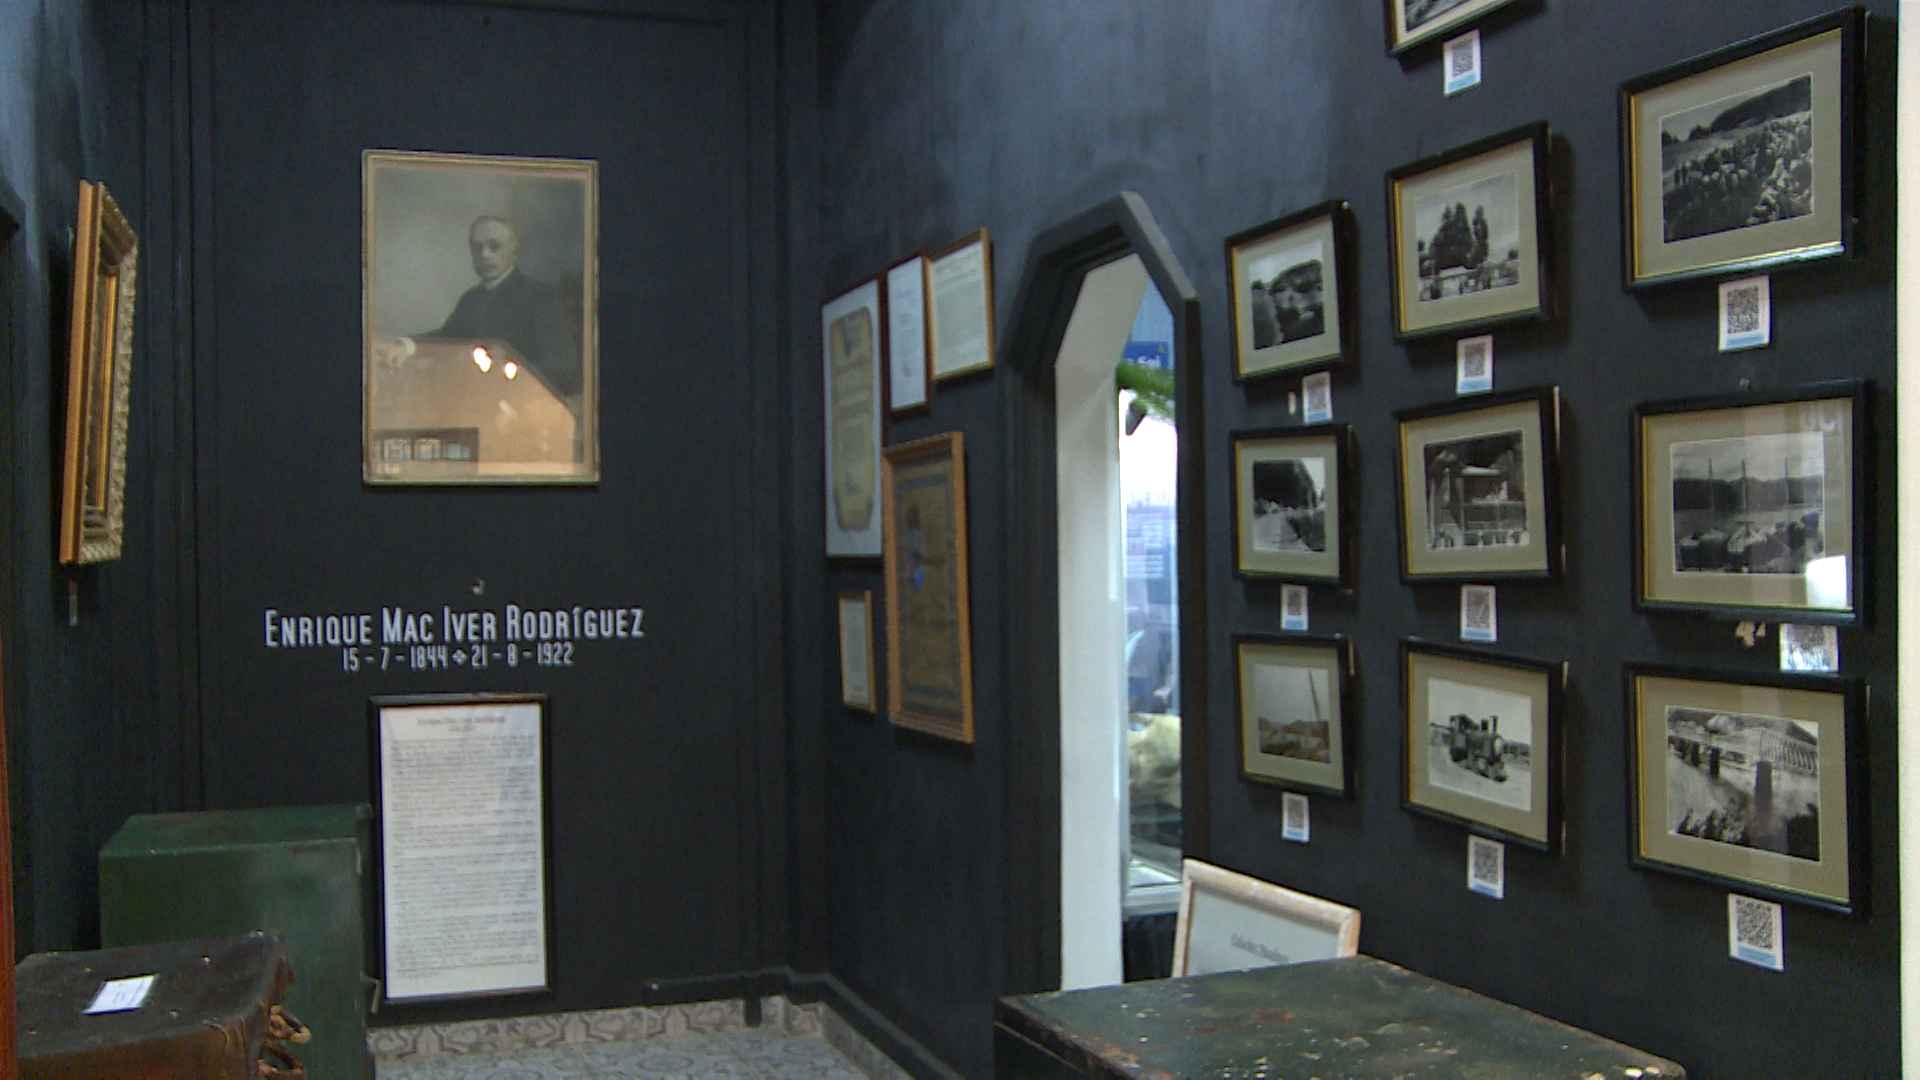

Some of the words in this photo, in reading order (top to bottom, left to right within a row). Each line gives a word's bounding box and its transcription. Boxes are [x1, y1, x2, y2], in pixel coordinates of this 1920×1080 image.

[264, 608, 374, 647] ENRIQUE
[381, 605, 435, 644] MAC
[443, 604, 497, 643] IVER
[505, 602, 645, 641] RODRÍGUEZ
